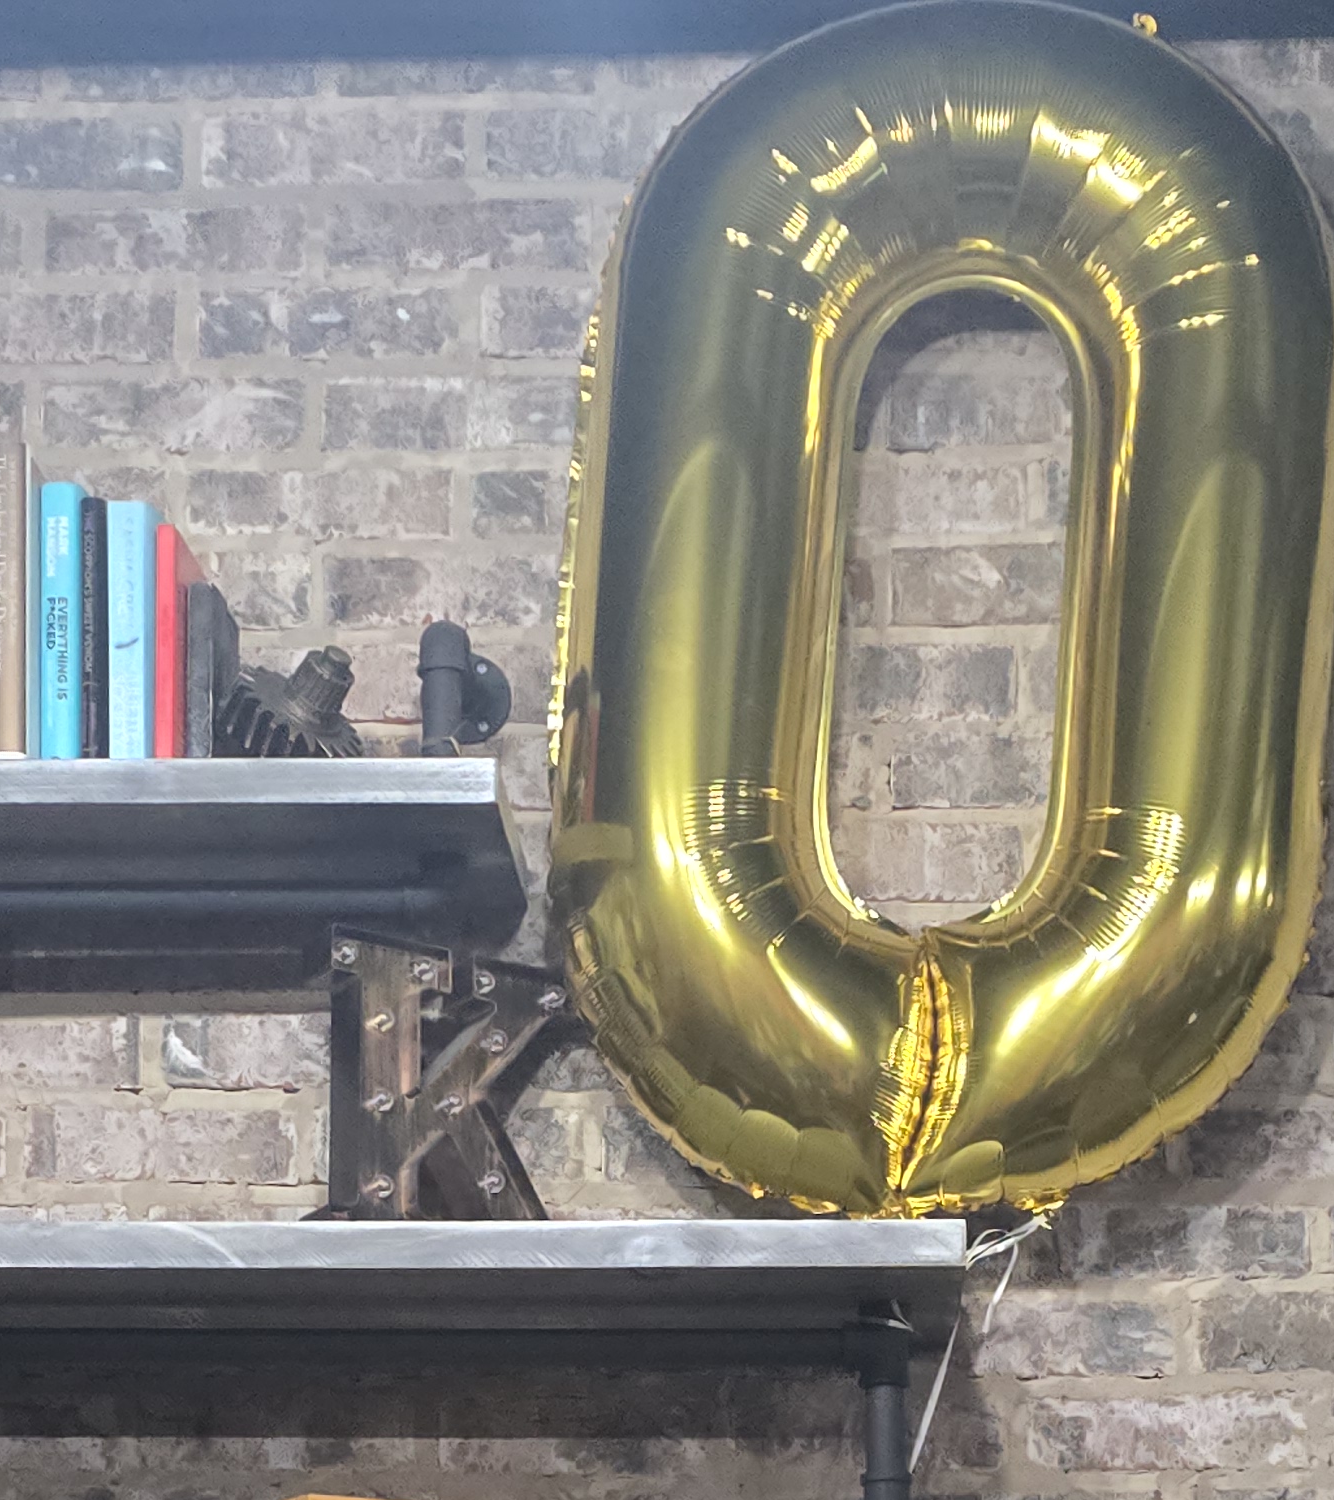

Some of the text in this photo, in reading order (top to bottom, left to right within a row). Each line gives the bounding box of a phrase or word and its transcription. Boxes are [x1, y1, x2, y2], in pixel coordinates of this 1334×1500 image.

[57, 597, 69, 701] EVERYTHING IS
[329, 922, 568, 1221] K
